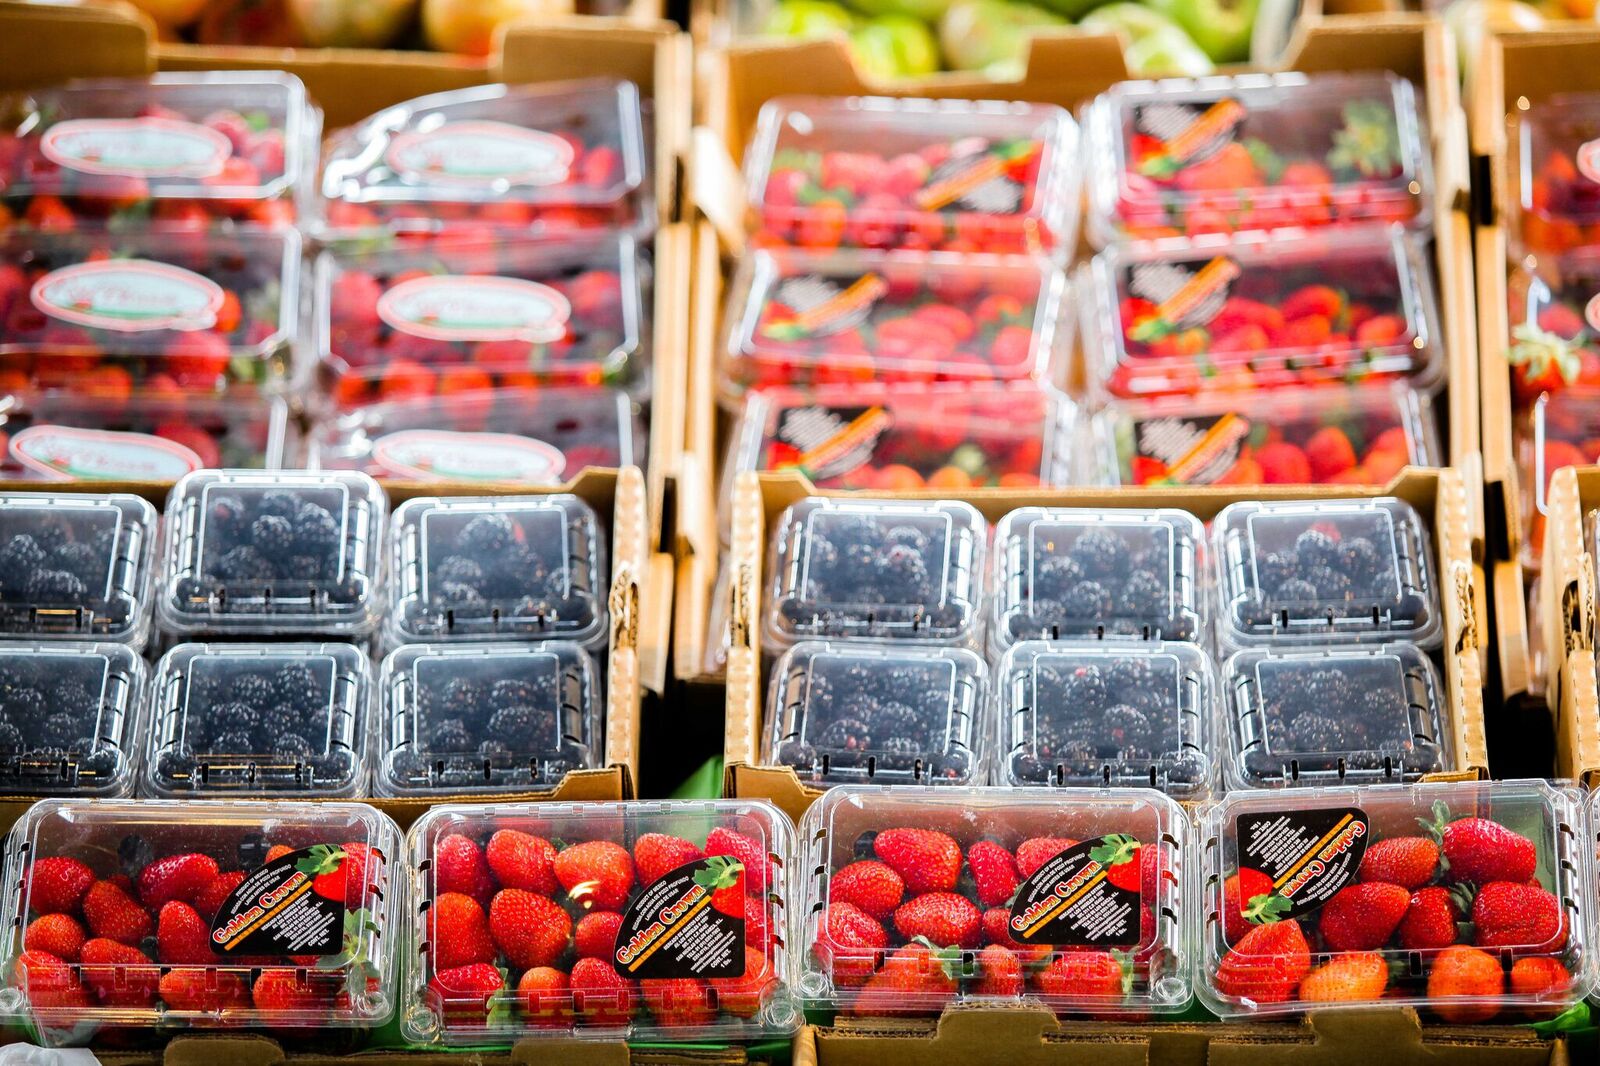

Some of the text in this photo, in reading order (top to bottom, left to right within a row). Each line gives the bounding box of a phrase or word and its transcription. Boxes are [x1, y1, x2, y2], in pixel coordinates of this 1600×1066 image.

[1318, 822, 1367, 862] Golden
[254, 868, 269, 880] MEXICO
[653, 880, 667, 893] MEXICO
[1279, 860, 1325, 900] Crown
[212, 906, 264, 943] Golden
[259, 871, 308, 908] Crown
[1010, 894, 1061, 930] Golden
[1055, 860, 1102, 897] Crown
[615, 922, 665, 963] Golden
[659, 883, 706, 924] Crown
